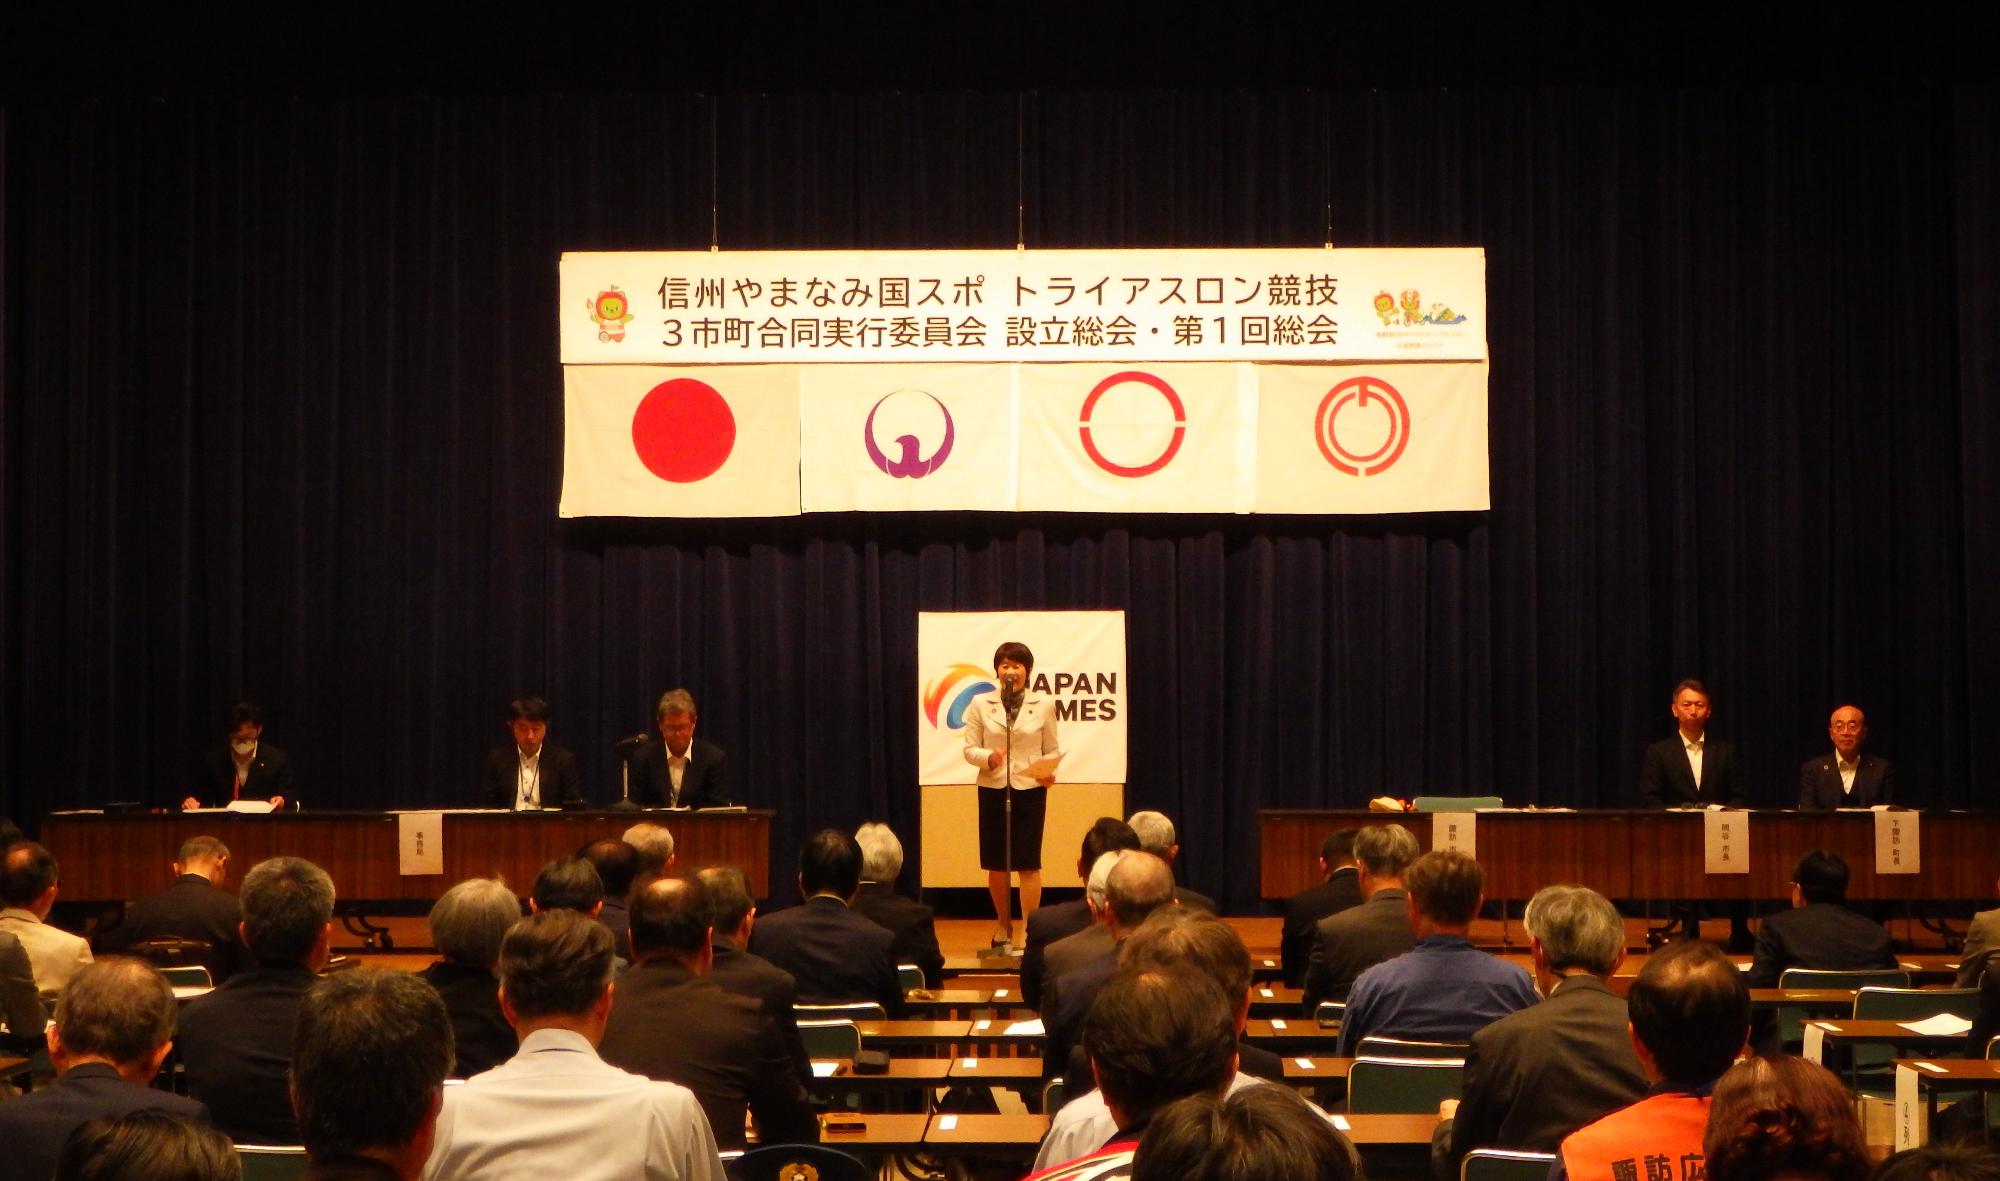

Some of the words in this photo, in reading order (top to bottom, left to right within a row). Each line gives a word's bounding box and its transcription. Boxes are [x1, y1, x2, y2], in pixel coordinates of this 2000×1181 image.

[658, 274, 985, 309] 信州やまなみ国スポ
[1016, 273, 1338, 307] トライアスロン競技
[662, 315, 987, 348] 3市町合同実行委員会
[1025, 672, 1117, 695] APAN
[1056, 698, 1117, 722] MES
